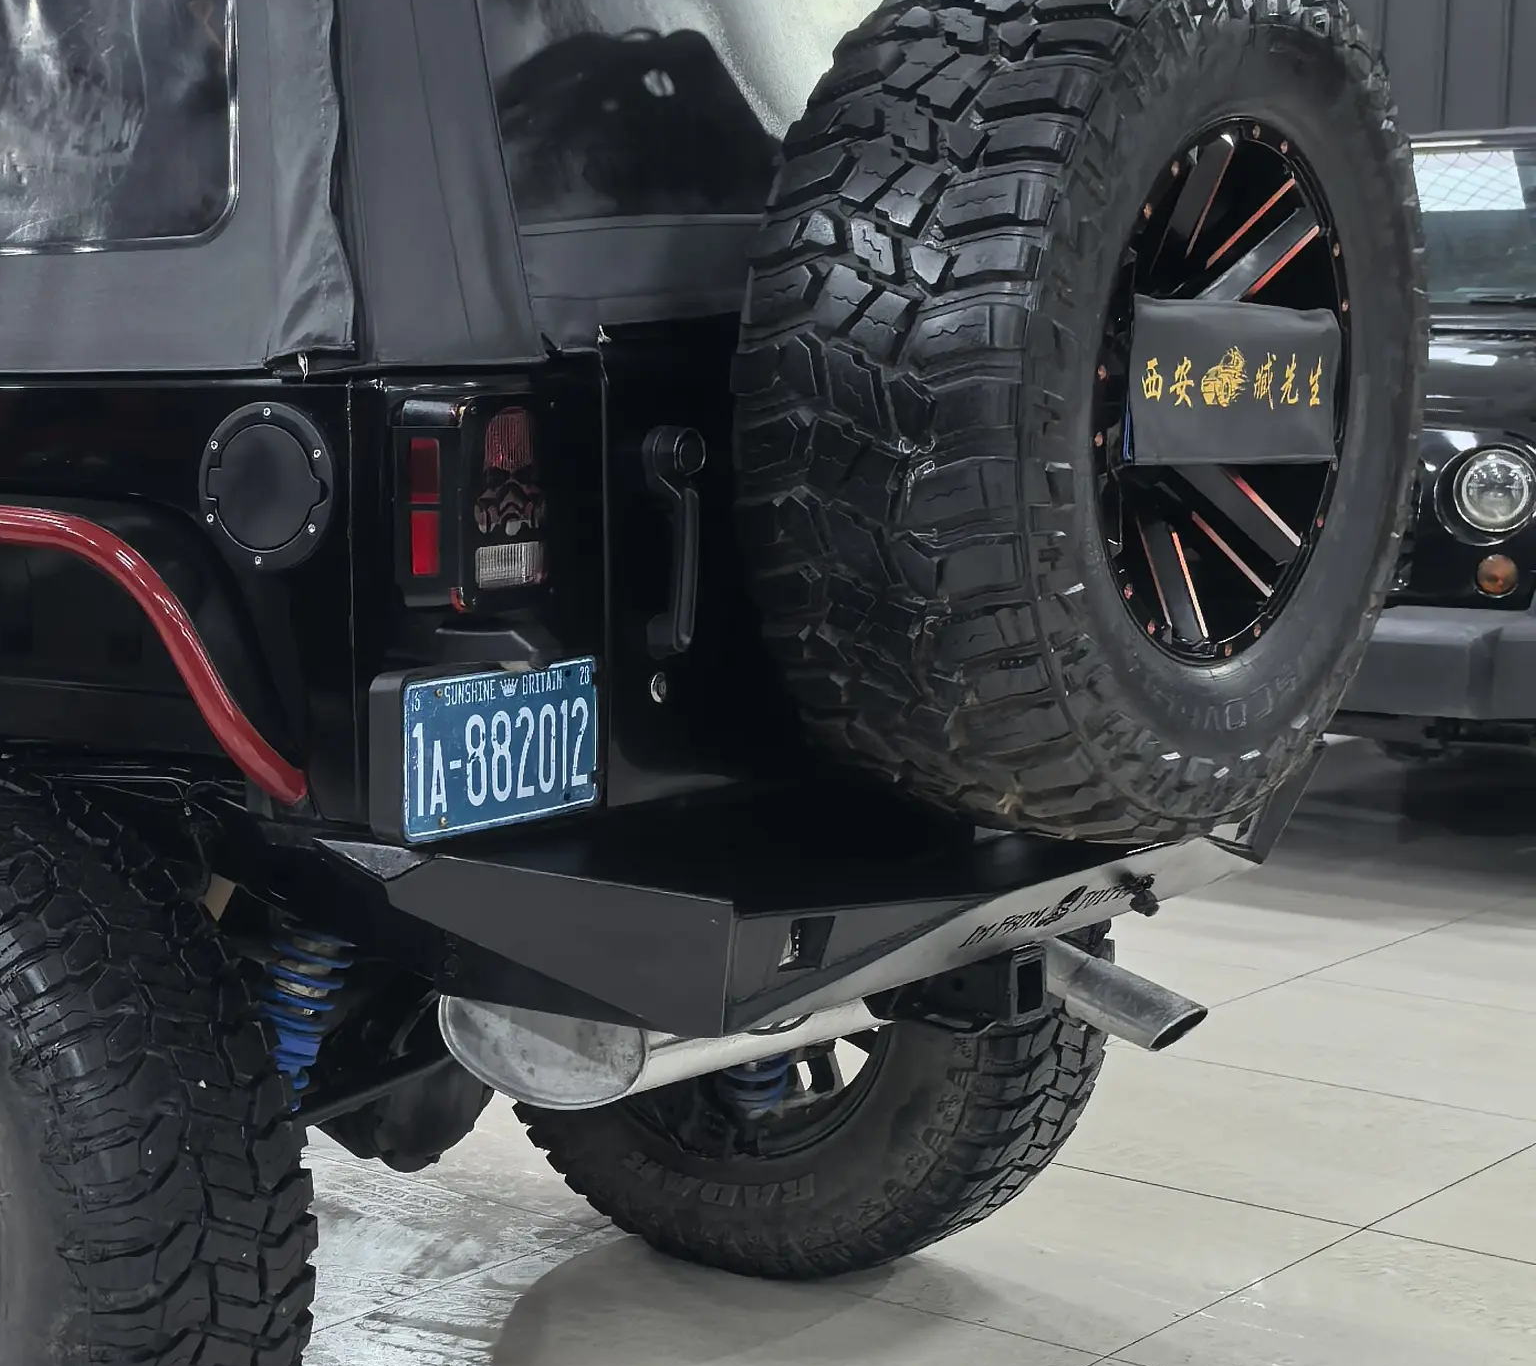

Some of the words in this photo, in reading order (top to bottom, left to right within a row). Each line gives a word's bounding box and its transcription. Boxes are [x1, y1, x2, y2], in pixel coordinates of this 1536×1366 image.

[1141, 356, 1196, 409] 西安
[444, 679, 497, 707] SUNSHINE
[522, 669, 563, 695] BRITAIN
[412, 697, 589, 817] 1A-882012
